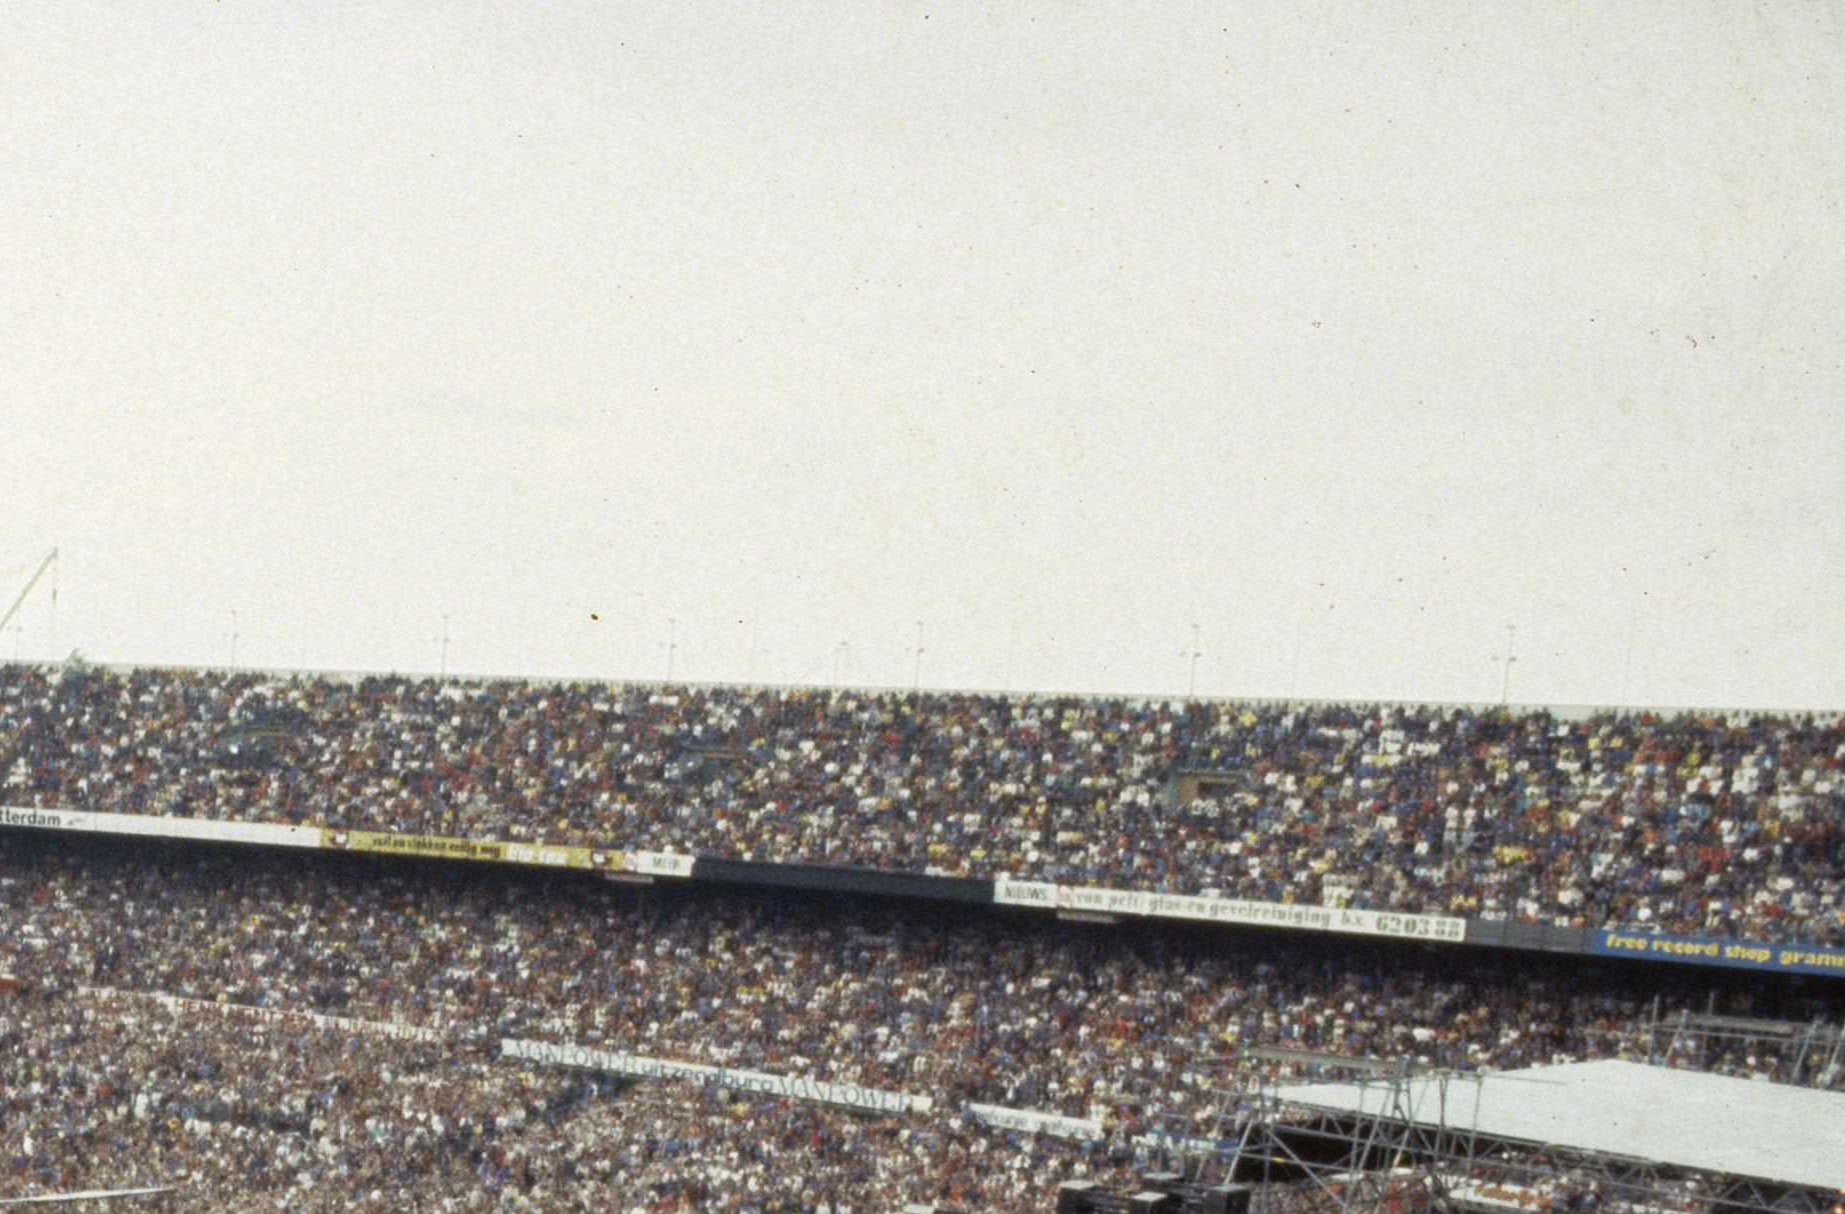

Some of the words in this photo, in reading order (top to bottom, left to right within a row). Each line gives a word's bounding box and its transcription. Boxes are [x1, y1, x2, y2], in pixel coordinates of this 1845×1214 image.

[1004, 885, 1048, 902] NIEUWS
[1076, 893, 1103, 906] van
[1606, 933, 1648, 951] free
[1652, 939, 1720, 957] record
[1724, 944, 1771, 963] shop
[514, 1042, 637, 1073] MANPOWER
[778, 1077, 915, 1113] MANPOWER
